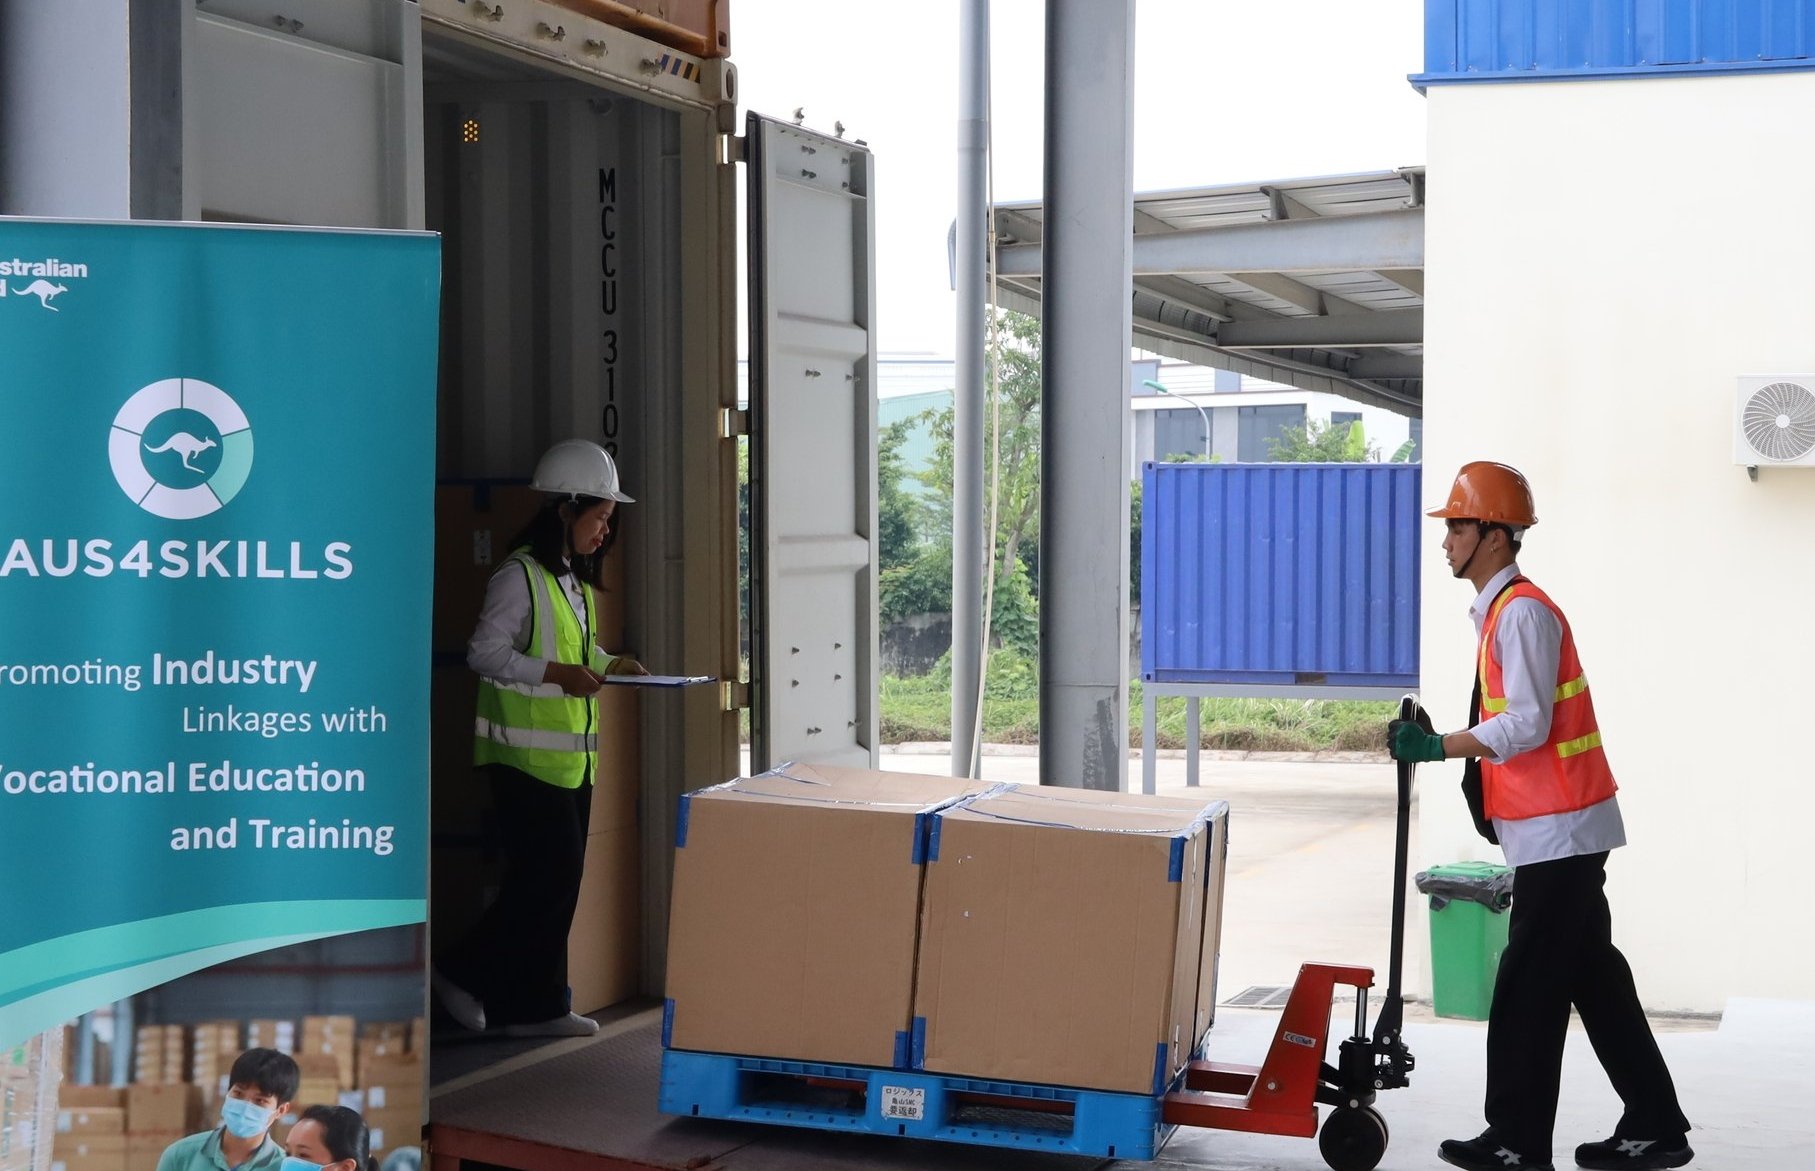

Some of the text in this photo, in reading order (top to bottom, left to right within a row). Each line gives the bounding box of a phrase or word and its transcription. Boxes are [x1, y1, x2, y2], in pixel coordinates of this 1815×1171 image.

[599, 167, 617, 315] MCCU
[0, 538, 353, 580] AUS4SKILLS
[153, 650, 318, 693] Industry
[183, 704, 387, 739] Linkages with
[0, 760, 366, 794] ocational Education
[170, 817, 395, 856] and Training
